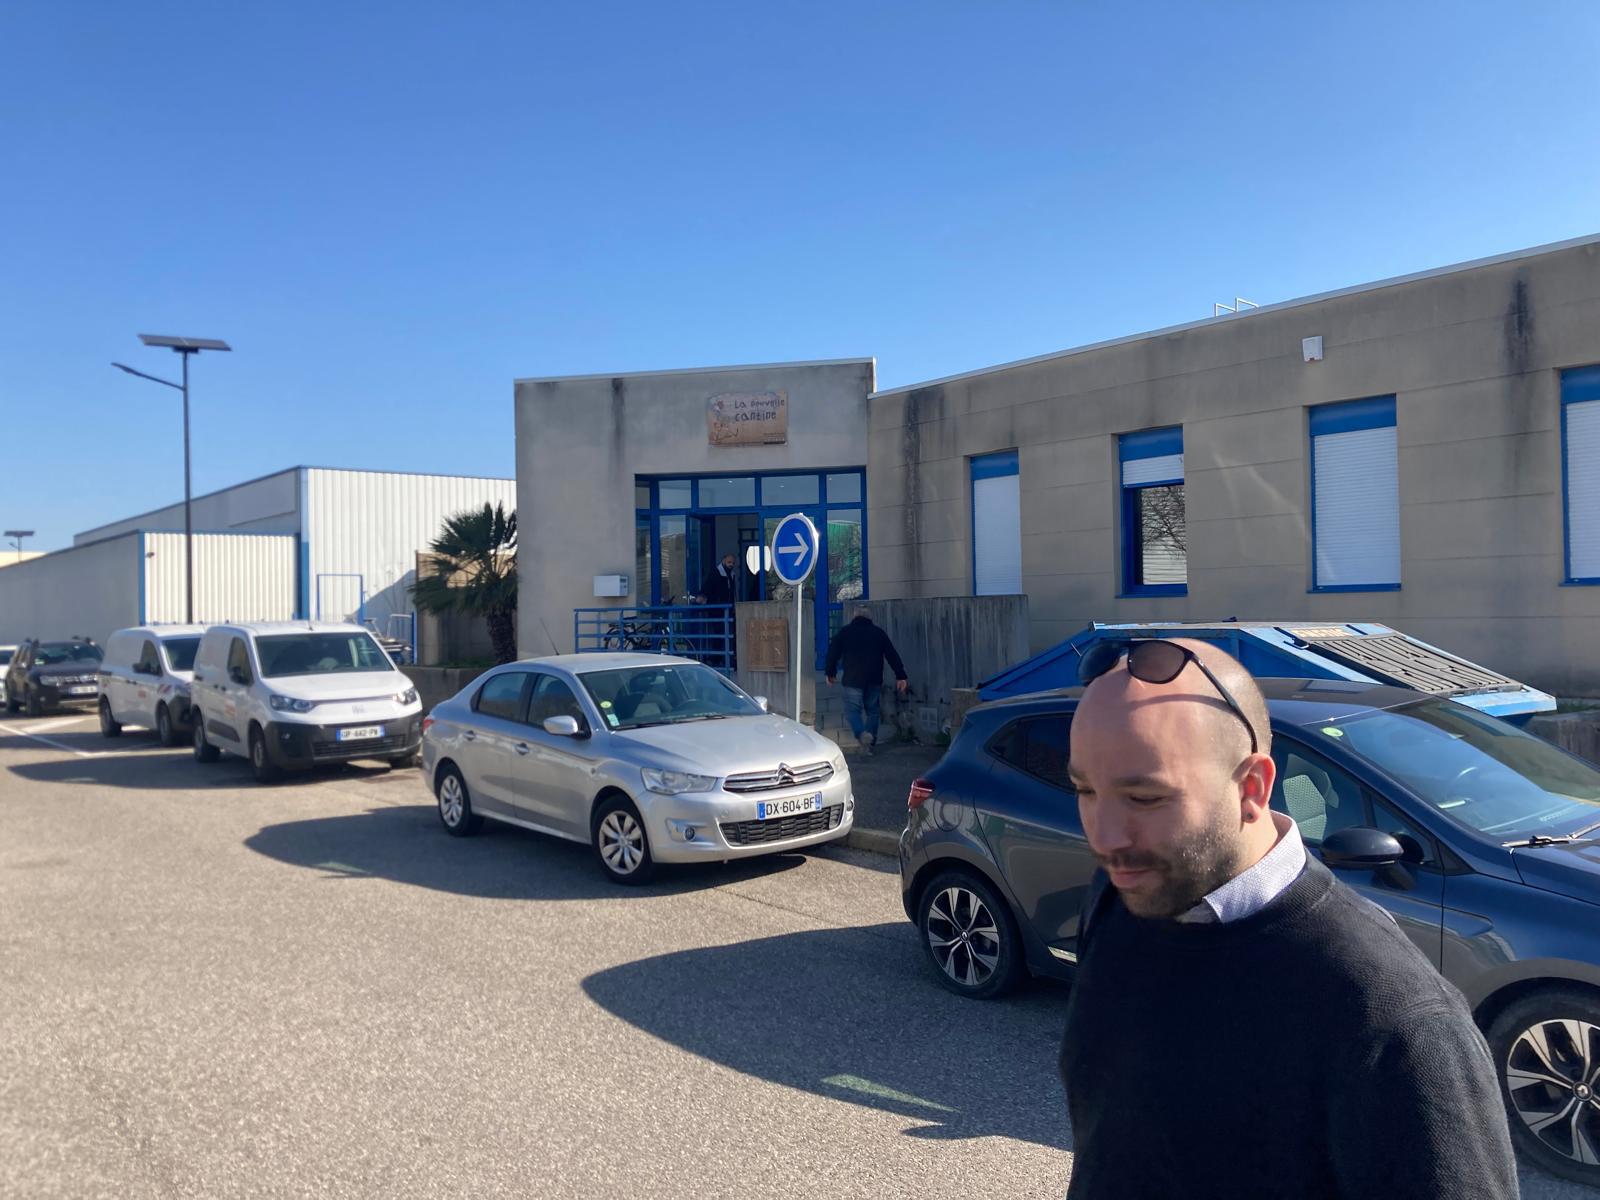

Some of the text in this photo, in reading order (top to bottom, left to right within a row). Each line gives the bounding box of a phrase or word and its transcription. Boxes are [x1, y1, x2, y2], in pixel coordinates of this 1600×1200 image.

[734, 399, 746, 409] La
[734, 411, 777, 422] cantine
[766, 797, 815, 816] DX-604-BF
